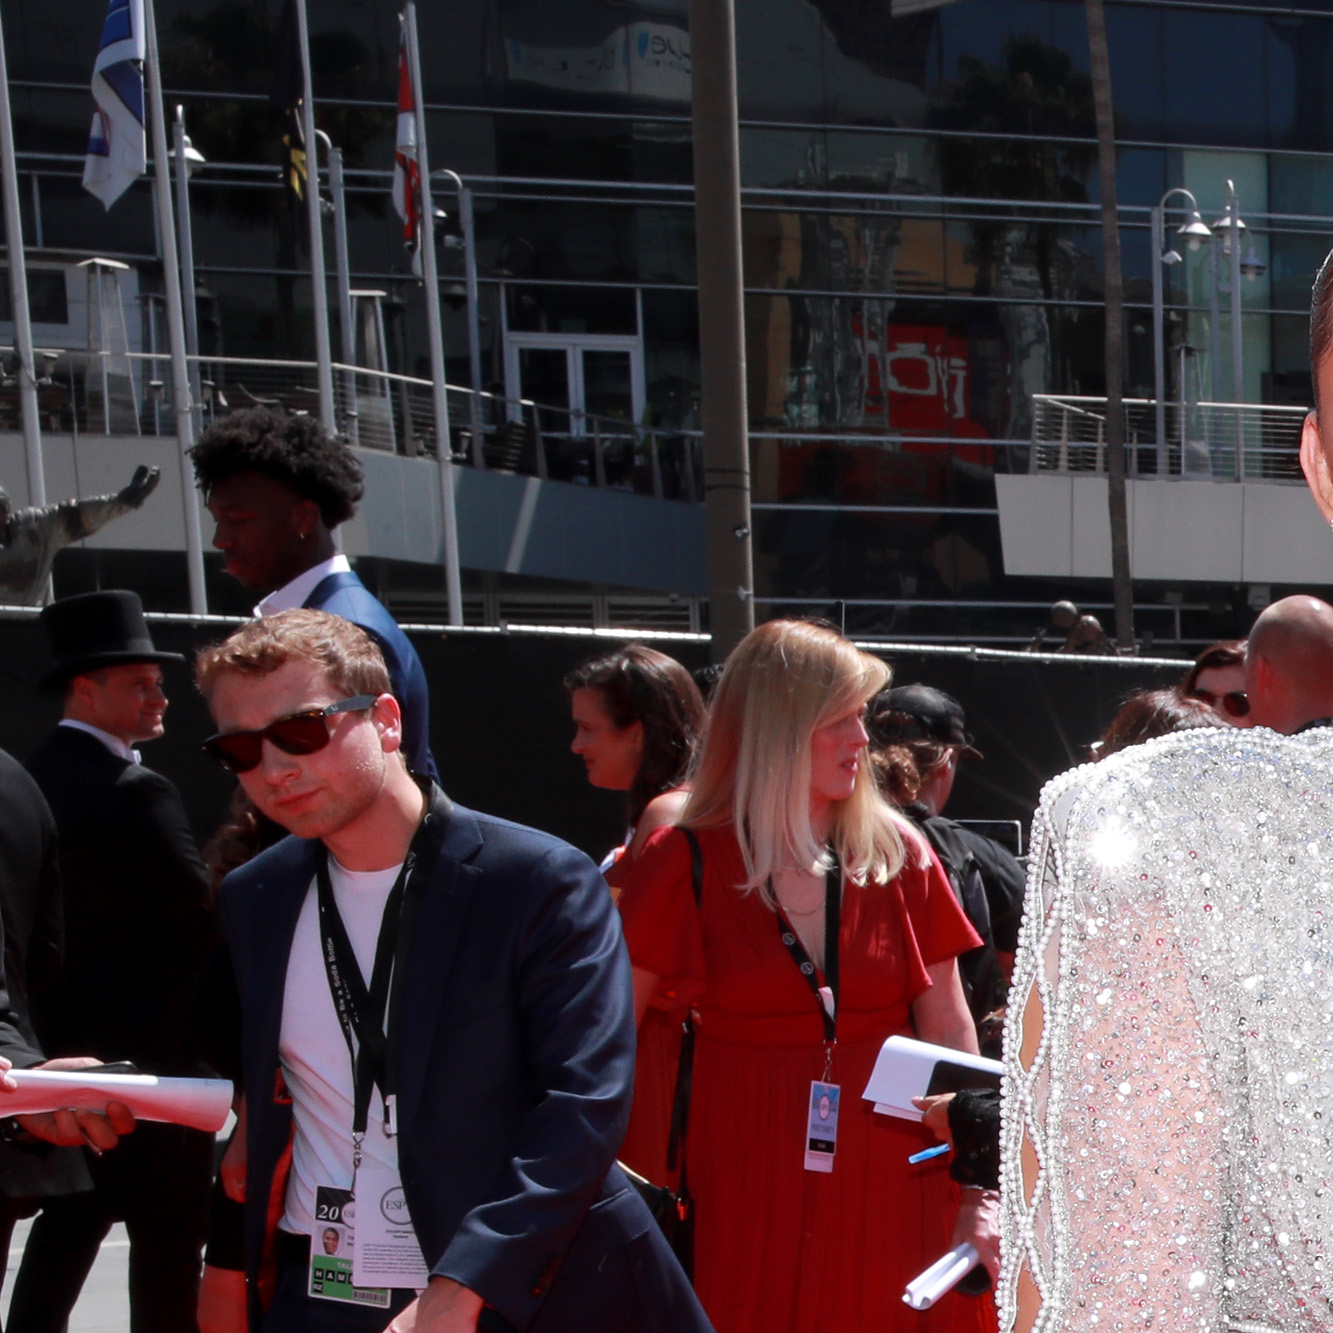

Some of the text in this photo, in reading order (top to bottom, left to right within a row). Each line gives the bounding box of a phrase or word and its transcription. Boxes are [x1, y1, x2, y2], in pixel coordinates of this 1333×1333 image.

[327, 937, 336, 962] Bottle
[331, 965, 341, 987] Soda
[318, 1204, 340, 1220] 20
[386, 1200, 406, 1209] ESP
